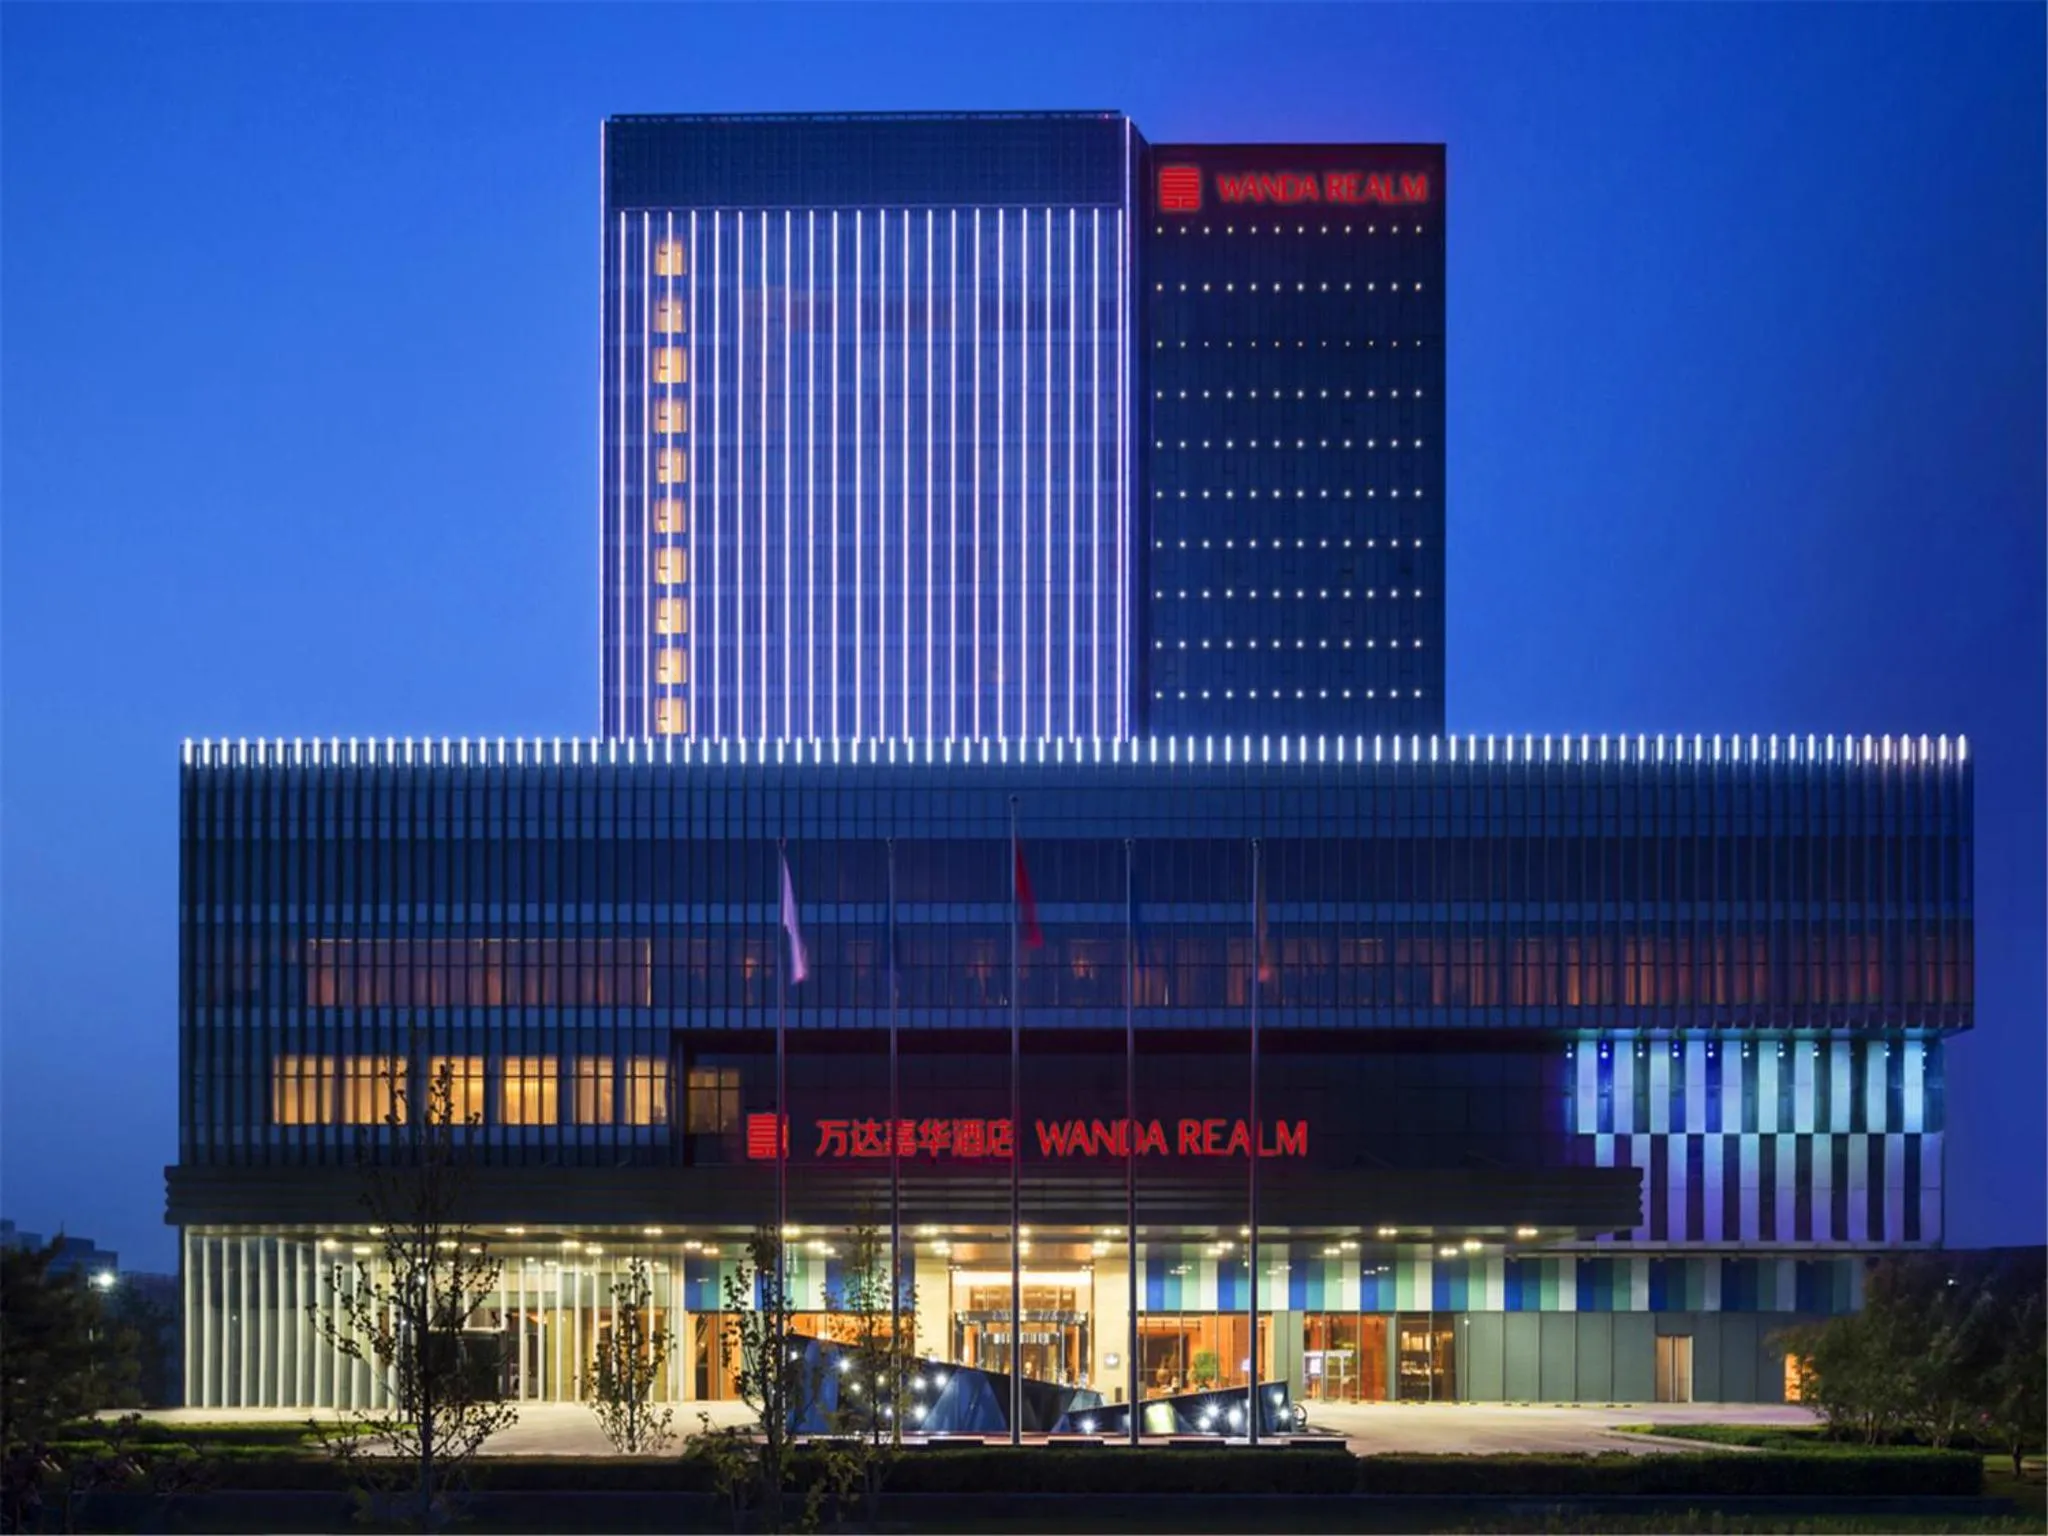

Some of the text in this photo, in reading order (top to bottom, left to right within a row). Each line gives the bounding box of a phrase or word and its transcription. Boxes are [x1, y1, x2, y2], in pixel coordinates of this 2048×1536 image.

[1217, 173, 1428, 204] WANDA REALM
[816, 1119, 1014, 1157] 万达嘉华酒店
[1035, 1119, 1308, 1157] WANDA REALM
